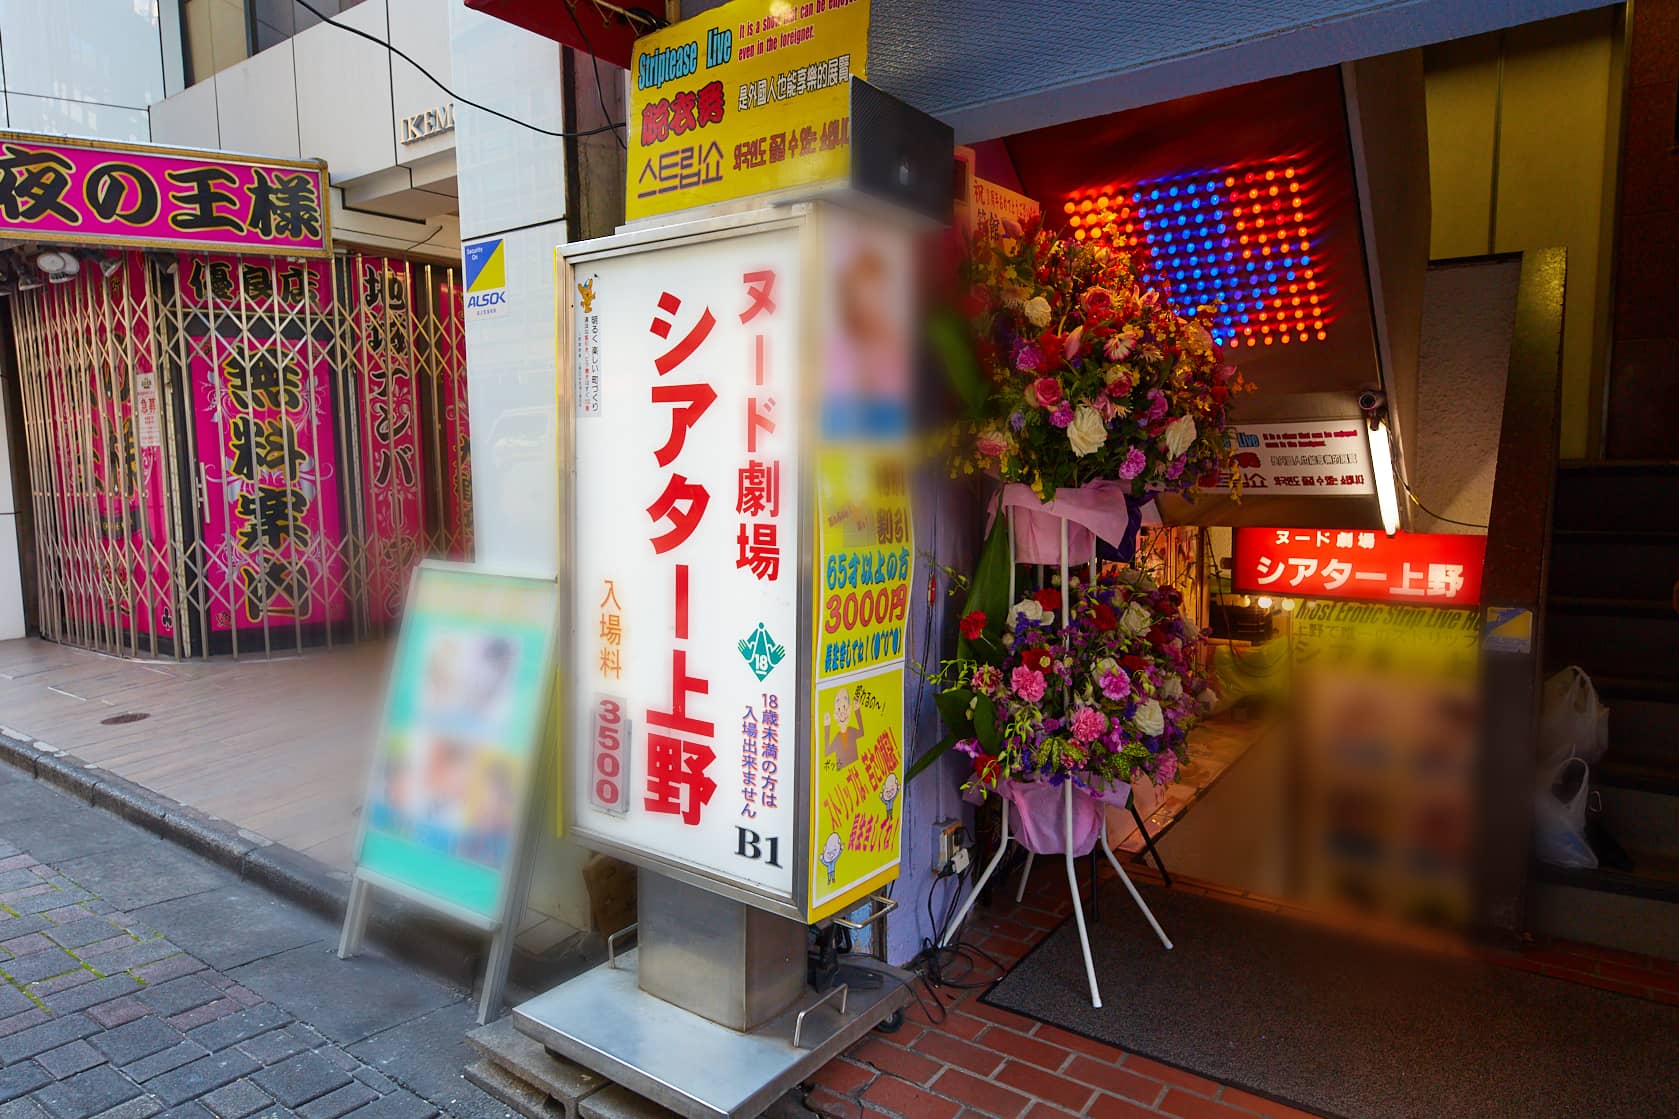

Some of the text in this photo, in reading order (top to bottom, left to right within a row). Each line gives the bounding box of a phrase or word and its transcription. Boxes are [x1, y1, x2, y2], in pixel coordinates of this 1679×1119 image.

[739, 24, 745, 40] It
[747, 21, 753, 36] is
[755, 20, 760, 34] a
[800, 3, 813, 19] can
[816, 0, 826, 14] be
[638, 27, 732, 91] Striptease Live
[738, 44, 754, 61] even
[757, 39, 764, 56] in
[766, 35, 778, 52] the
[788, 129, 798, 159] 수
[0, 145, 320, 240] 夜の王様
[638, 140, 724, 199] 스트립쇼
[188, 257, 320, 302] 優良店
[467, 291, 506, 308] ALSOK
[735, 269, 781, 582] ヌード劇場
[222, 343, 312, 623] 無料案内
[643, 291, 719, 827] シアター上野
[1275, 530, 1375, 549] ヌード劇場
[1256, 556, 1464, 598] シアター上野
[600, 580, 622, 680] 入場料
[825, 584, 907, 634] 3000円
[1335, 603, 1382, 624] Erotic
[1384, 605, 1427, 629] Strip
[1425, 607, 1462, 628] Live
[754, 653, 768, 671] 18
[595, 700, 621, 804] 3500
[741, 705, 758, 819] 入場出来ません
[761, 693, 778, 810] 18歳未満の方は
[734, 824, 783, 869] B1
